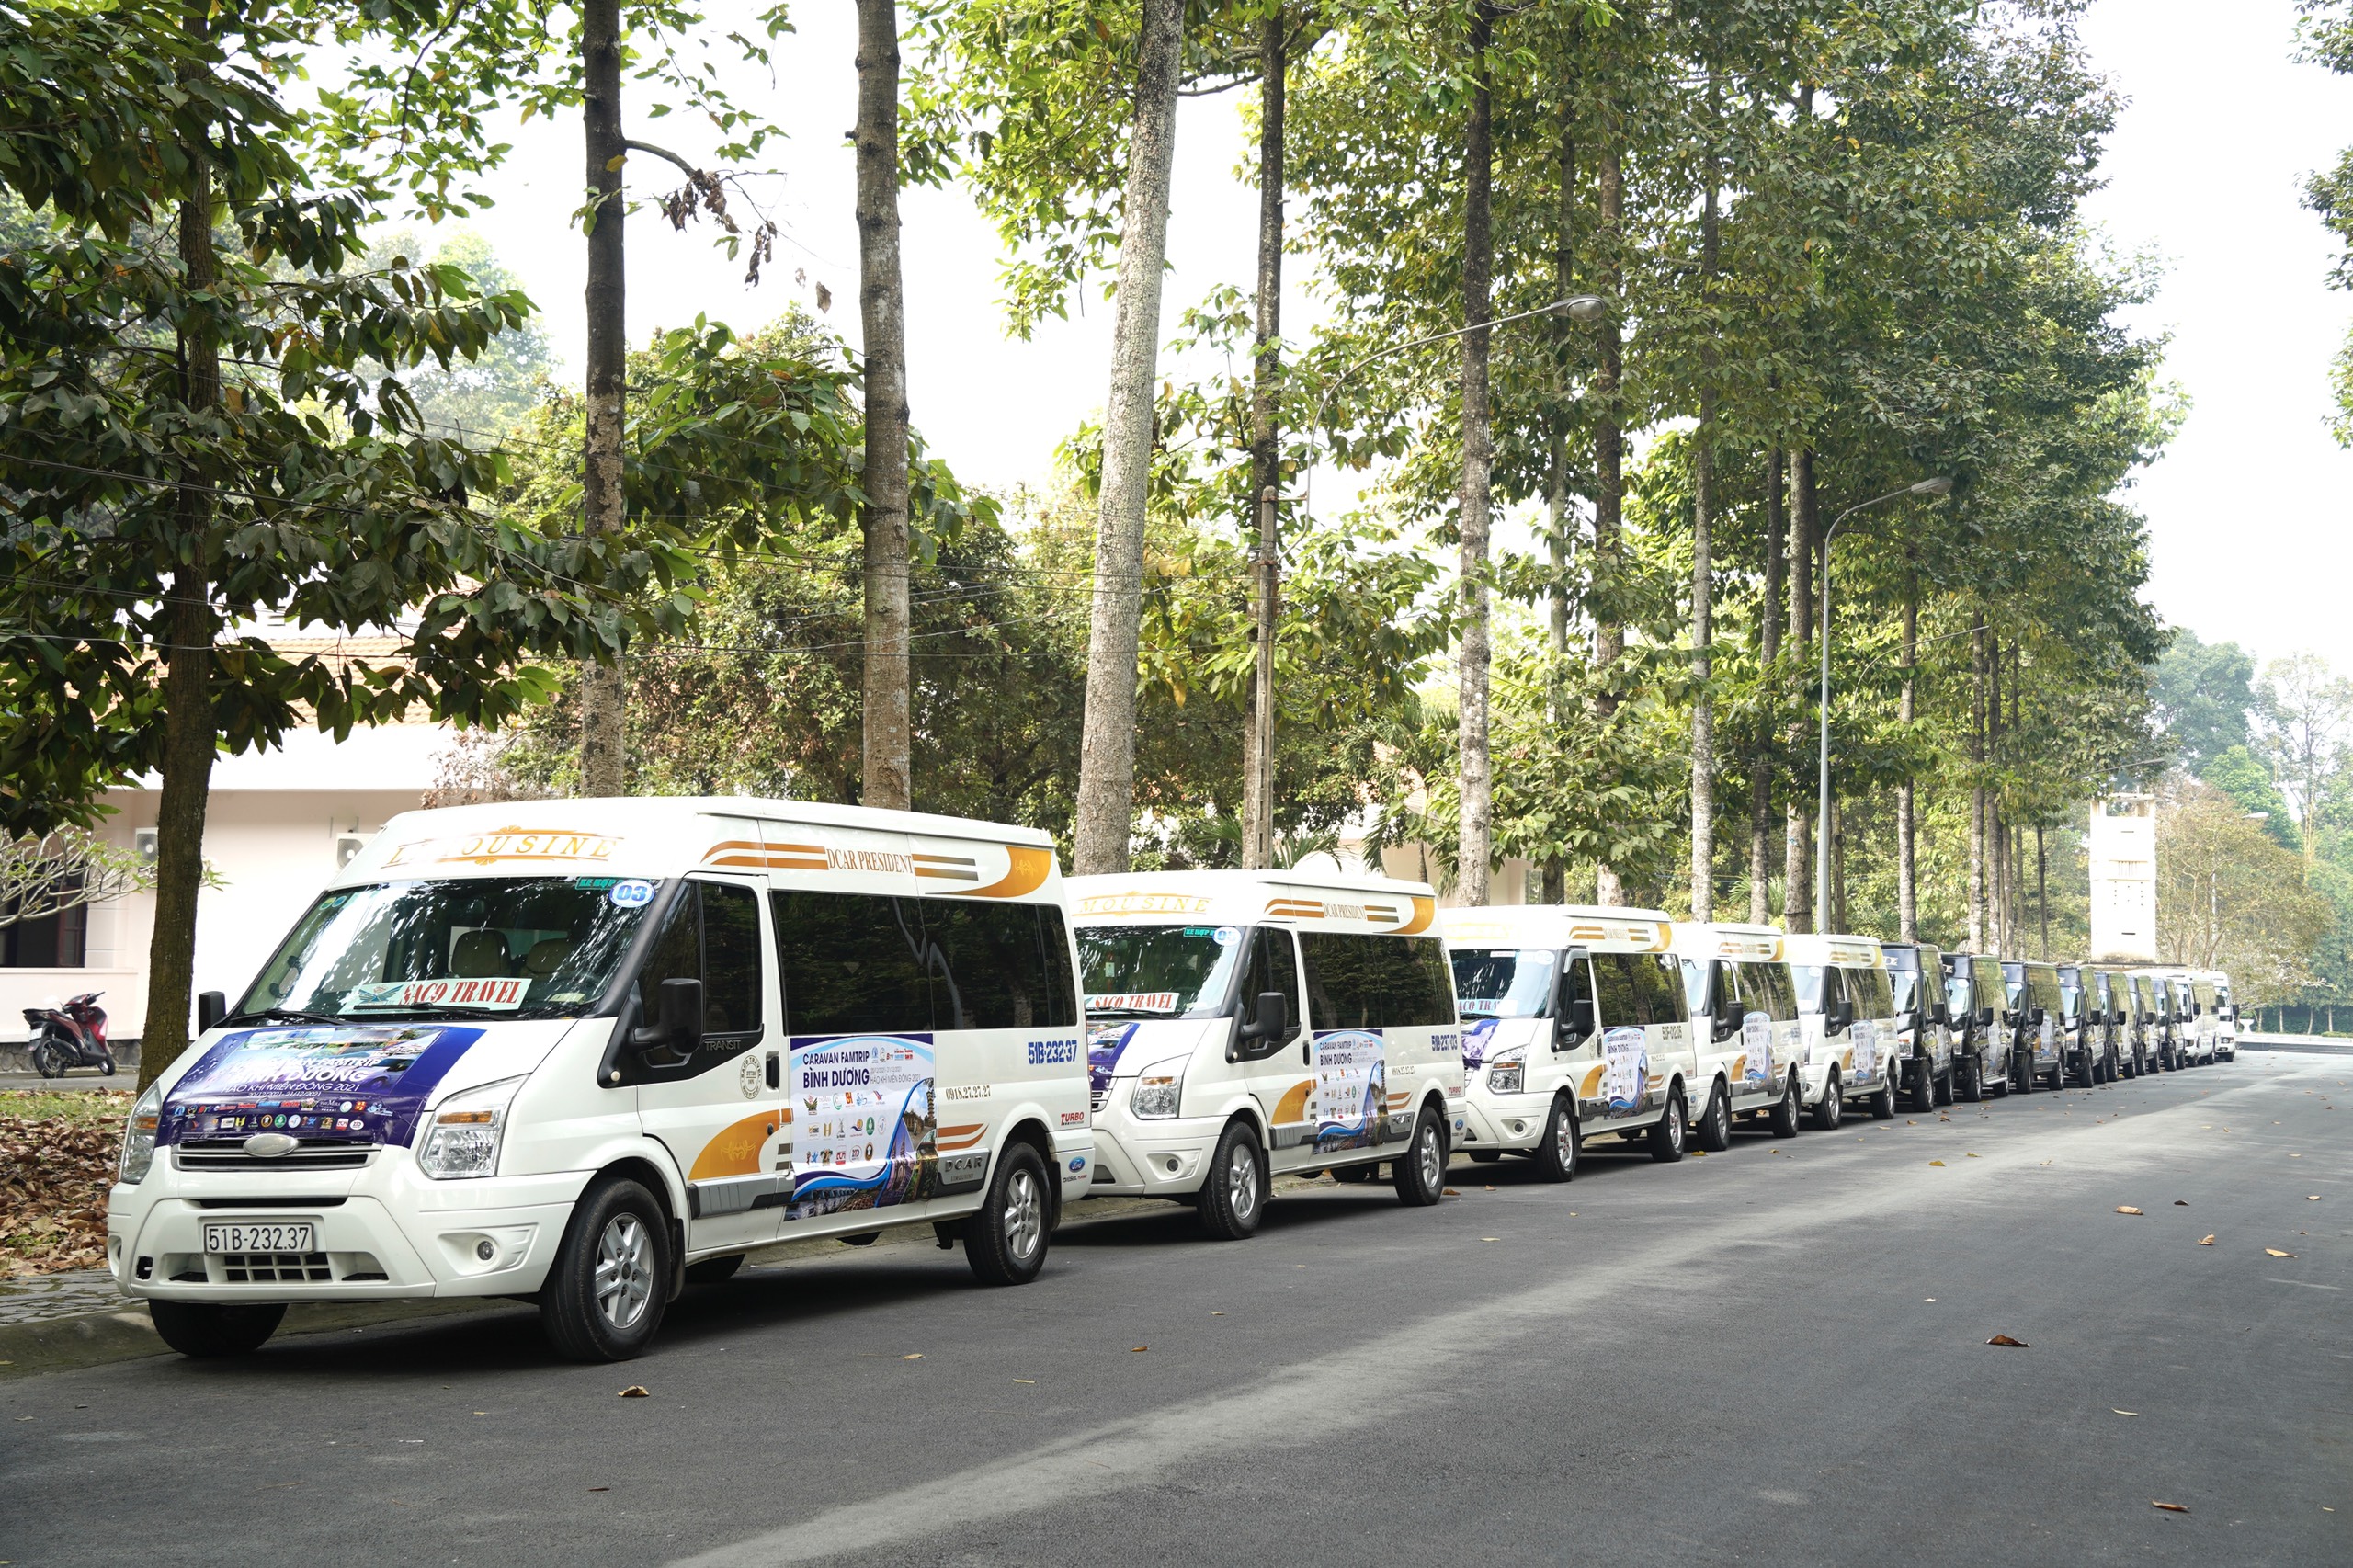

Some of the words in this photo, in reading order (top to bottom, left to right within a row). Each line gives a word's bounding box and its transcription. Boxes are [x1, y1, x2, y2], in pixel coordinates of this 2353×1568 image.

[386, 835, 618, 865] LOUSINE
[827, 848, 858, 870] DCAR
[858, 851, 914, 874] PRESIDENT
[617, 885, 647, 902] 03
[1079, 897, 1210, 913] MOUSINE
[1323, 903, 1337, 917] DCAR
[1338, 904, 1366, 919] PRESIDENT
[399, 982, 449, 1006] SACO
[449, 981, 522, 1004] TRAVEL
[1095, 996, 1124, 1008] SACO
[1128, 994, 1174, 1009] TRAVEL
[1458, 1000, 1475, 1011] ACO
[704, 1040, 742, 1051] TRANSIT
[1320, 1041, 1336, 1051] CARAVAN
[802, 1052, 839, 1065] CARAVAN
[841, 1051, 870, 1063] FAMTRIP
[1320, 1051, 1333, 1066] BÌNH
[1334, 1052, 1352, 1065] DƯƠNG
[803, 1067, 828, 1089] BÌNH
[832, 1067, 870, 1087] DƯƠNG
[334, 1084, 360, 1092] 2021
[945, 1085, 992, 1101] 0918.27.27.27
[1061, 1111, 1085, 1126] TURBO
[945, 1155, 983, 1172] DCAR
[209, 1227, 309, 1251] 51B-232.37
